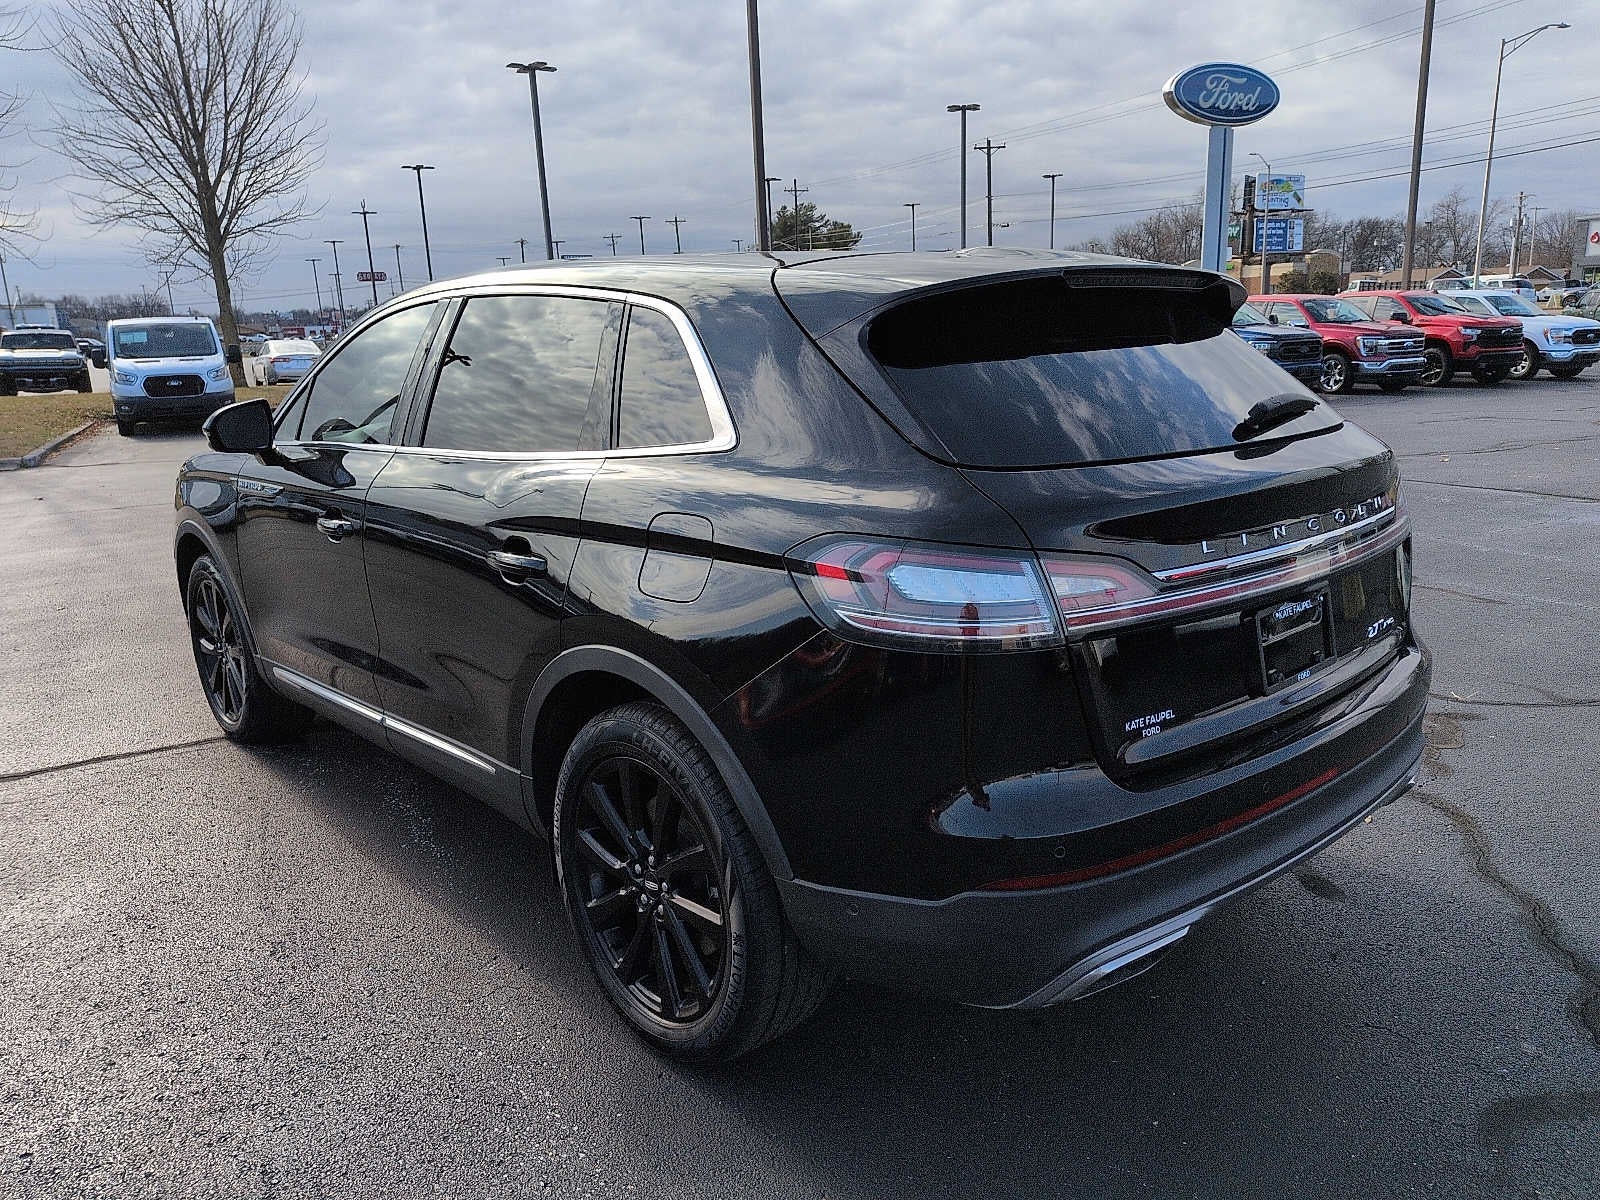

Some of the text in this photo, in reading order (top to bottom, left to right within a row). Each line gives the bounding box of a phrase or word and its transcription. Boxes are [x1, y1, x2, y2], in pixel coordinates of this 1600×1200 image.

[1199, 73, 1262, 111] Ford
[1201, 495, 1382, 554] LINCOLN
[1278, 606, 1294, 620] KATE
[1297, 670, 1311, 682] FORD
[1125, 709, 1176, 732] KATE FAUPEL
[1142, 725, 1161, 738] FORD
